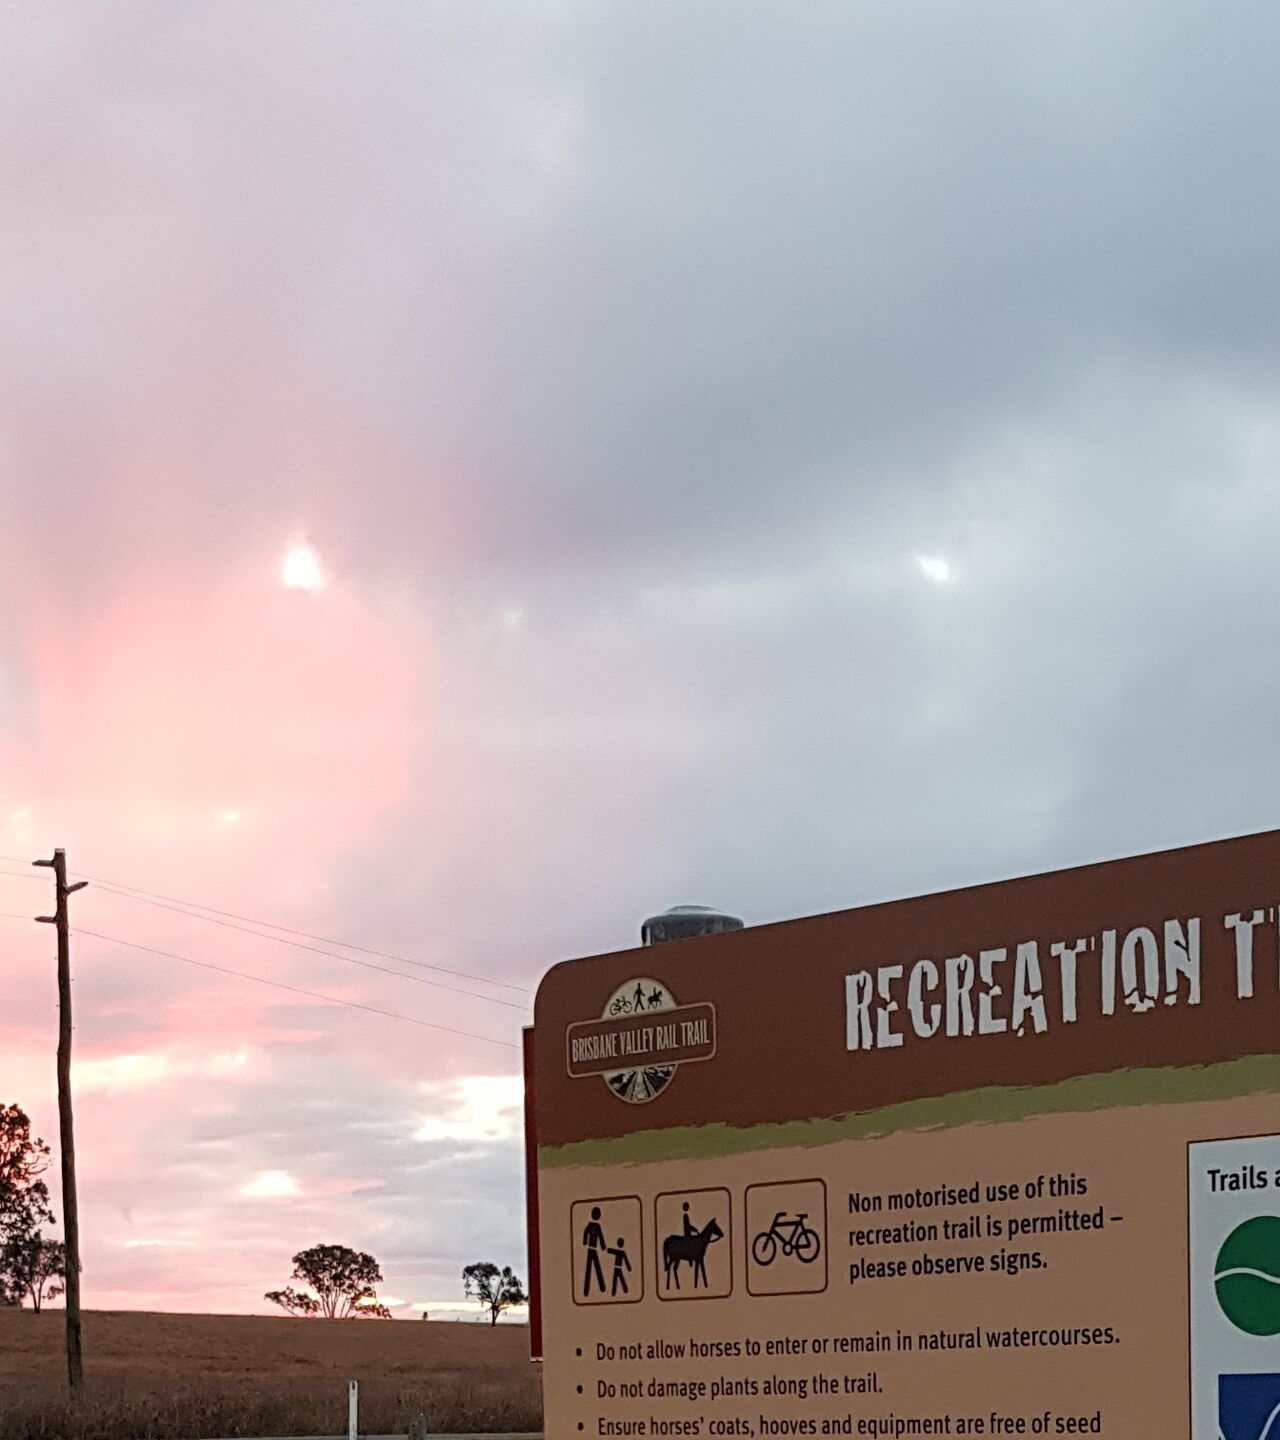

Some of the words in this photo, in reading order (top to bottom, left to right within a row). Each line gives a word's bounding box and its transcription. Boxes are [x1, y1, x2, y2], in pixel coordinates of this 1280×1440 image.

[845, 917, 1201, 1051] RECREATION
[571, 1032, 618, 1063] BRISBANE
[619, 1027, 654, 1056] VALLEY
[656, 1023, 679, 1051] RAIL
[680, 1018, 711, 1047] TRAIL
[848, 1192, 883, 1214] Non
[887, 1180, 980, 1211] motorised
[986, 1183, 1020, 1203] use
[1024, 1174, 1045, 1199] of
[1048, 1172, 1088, 1197] this
[1206, 1164, 1268, 1192] Trails
[848, 1220, 938, 1247] recreation
[942, 1215, 982, 1240] trail
[986, 1214, 1003, 1237] is
[1007, 1205, 1105, 1242] permitted
[849, 1257, 907, 1285] please
[911, 1253, 985, 1276] observe
[989, 1247, 1048, 1276] signs.
[596, 1342, 615, 1361] Do
[619, 1342, 643, 1360] not
[646, 1339, 686, 1360] allow
[689, 1338, 742, 1358] horses
[744, 1337, 761, 1357] to
[765, 1336, 809, 1356] enter
[811, 1338, 830, 1354] or
[833, 1330, 891, 1353] remain
[896, 1329, 912, 1351] in
[918, 1326, 982, 1350] natural
[985, 1327, 1120, 1348] watercourses.
[597, 1379, 617, 1399] Do
[620, 1380, 644, 1398] not
[647, 1377, 707, 1402] damage
[710, 1375, 759, 1401] plants
[763, 1374, 809, 1400] along
[812, 1373, 839, 1395] the
[843, 1372, 883, 1394] trail.
[598, 1417, 646, 1436] Ensure
[708, 1417, 755, 1439] coats,
[759, 1414, 817, 1436] hooves
[821, 1413, 852, 1435] and
[857, 1412, 952, 1440] equipment
[956, 1418, 985, 1435] are
[989, 1411, 1026, 1434] free
[1031, 1411, 1051, 1434] of
[1055, 1410, 1101, 1434] seed
